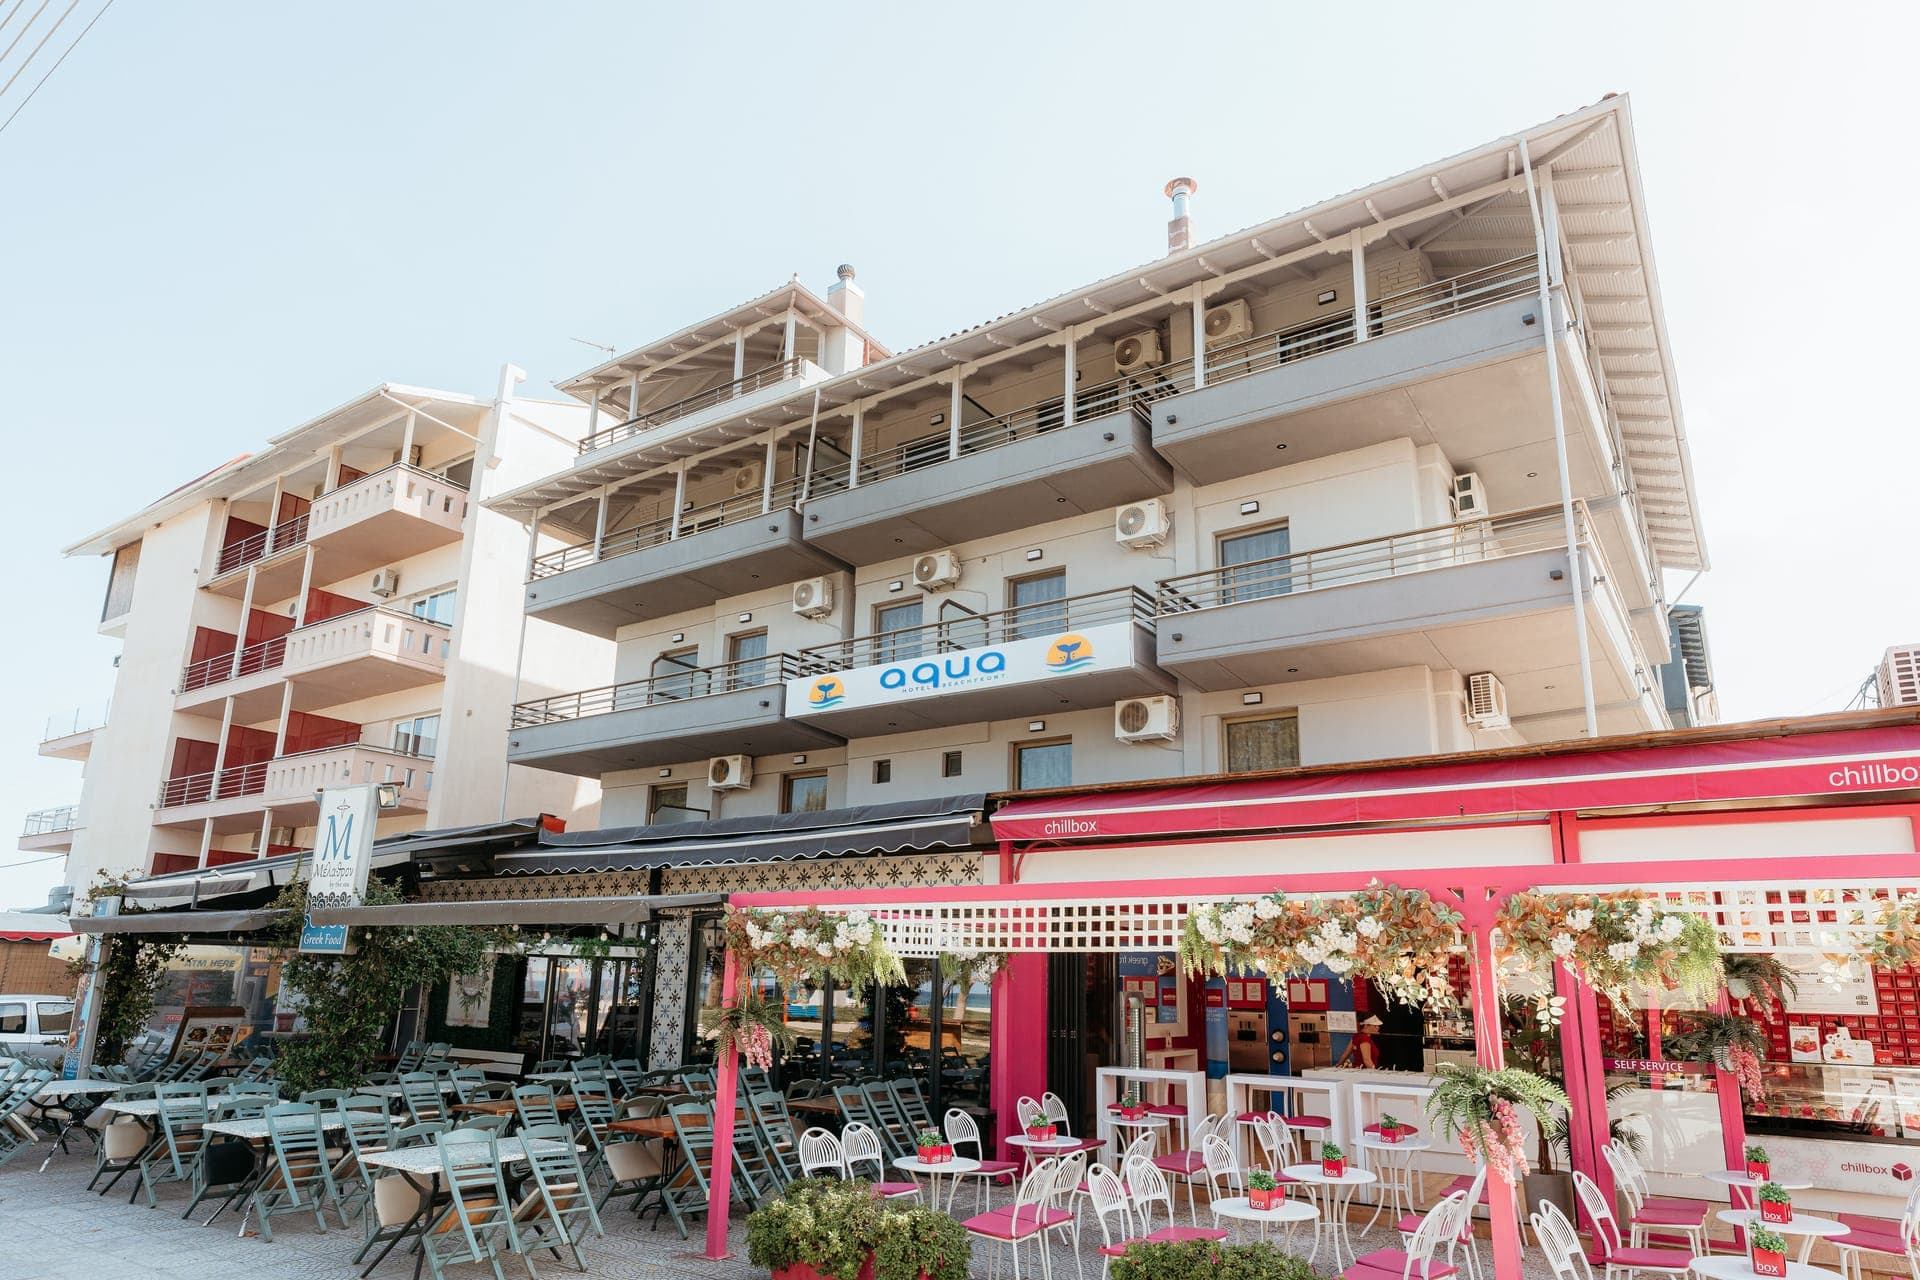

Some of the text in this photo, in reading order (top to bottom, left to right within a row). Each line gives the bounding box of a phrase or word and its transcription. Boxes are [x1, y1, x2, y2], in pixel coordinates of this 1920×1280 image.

[880, 652, 1005, 689] aqua
[942, 674, 1006, 688] BEACHFRONT
[1828, 763, 1920, 786] chillbo
[1044, 819, 1097, 834] chillbox
[322, 813, 354, 861] M
[304, 933, 342, 945] Greek Food
[184, 959, 236, 968] ATM HERE
[1614, 1060, 1684, 1072] SELF SERVICE
[1324, 1168, 1338, 1176] box
[1749, 1170, 1763, 1178] box
[1841, 1162, 1888, 1175] chillbox
[1251, 1201, 1265, 1209] box
[1763, 1210, 1782, 1221] box
[1756, 1262, 1778, 1274] box
